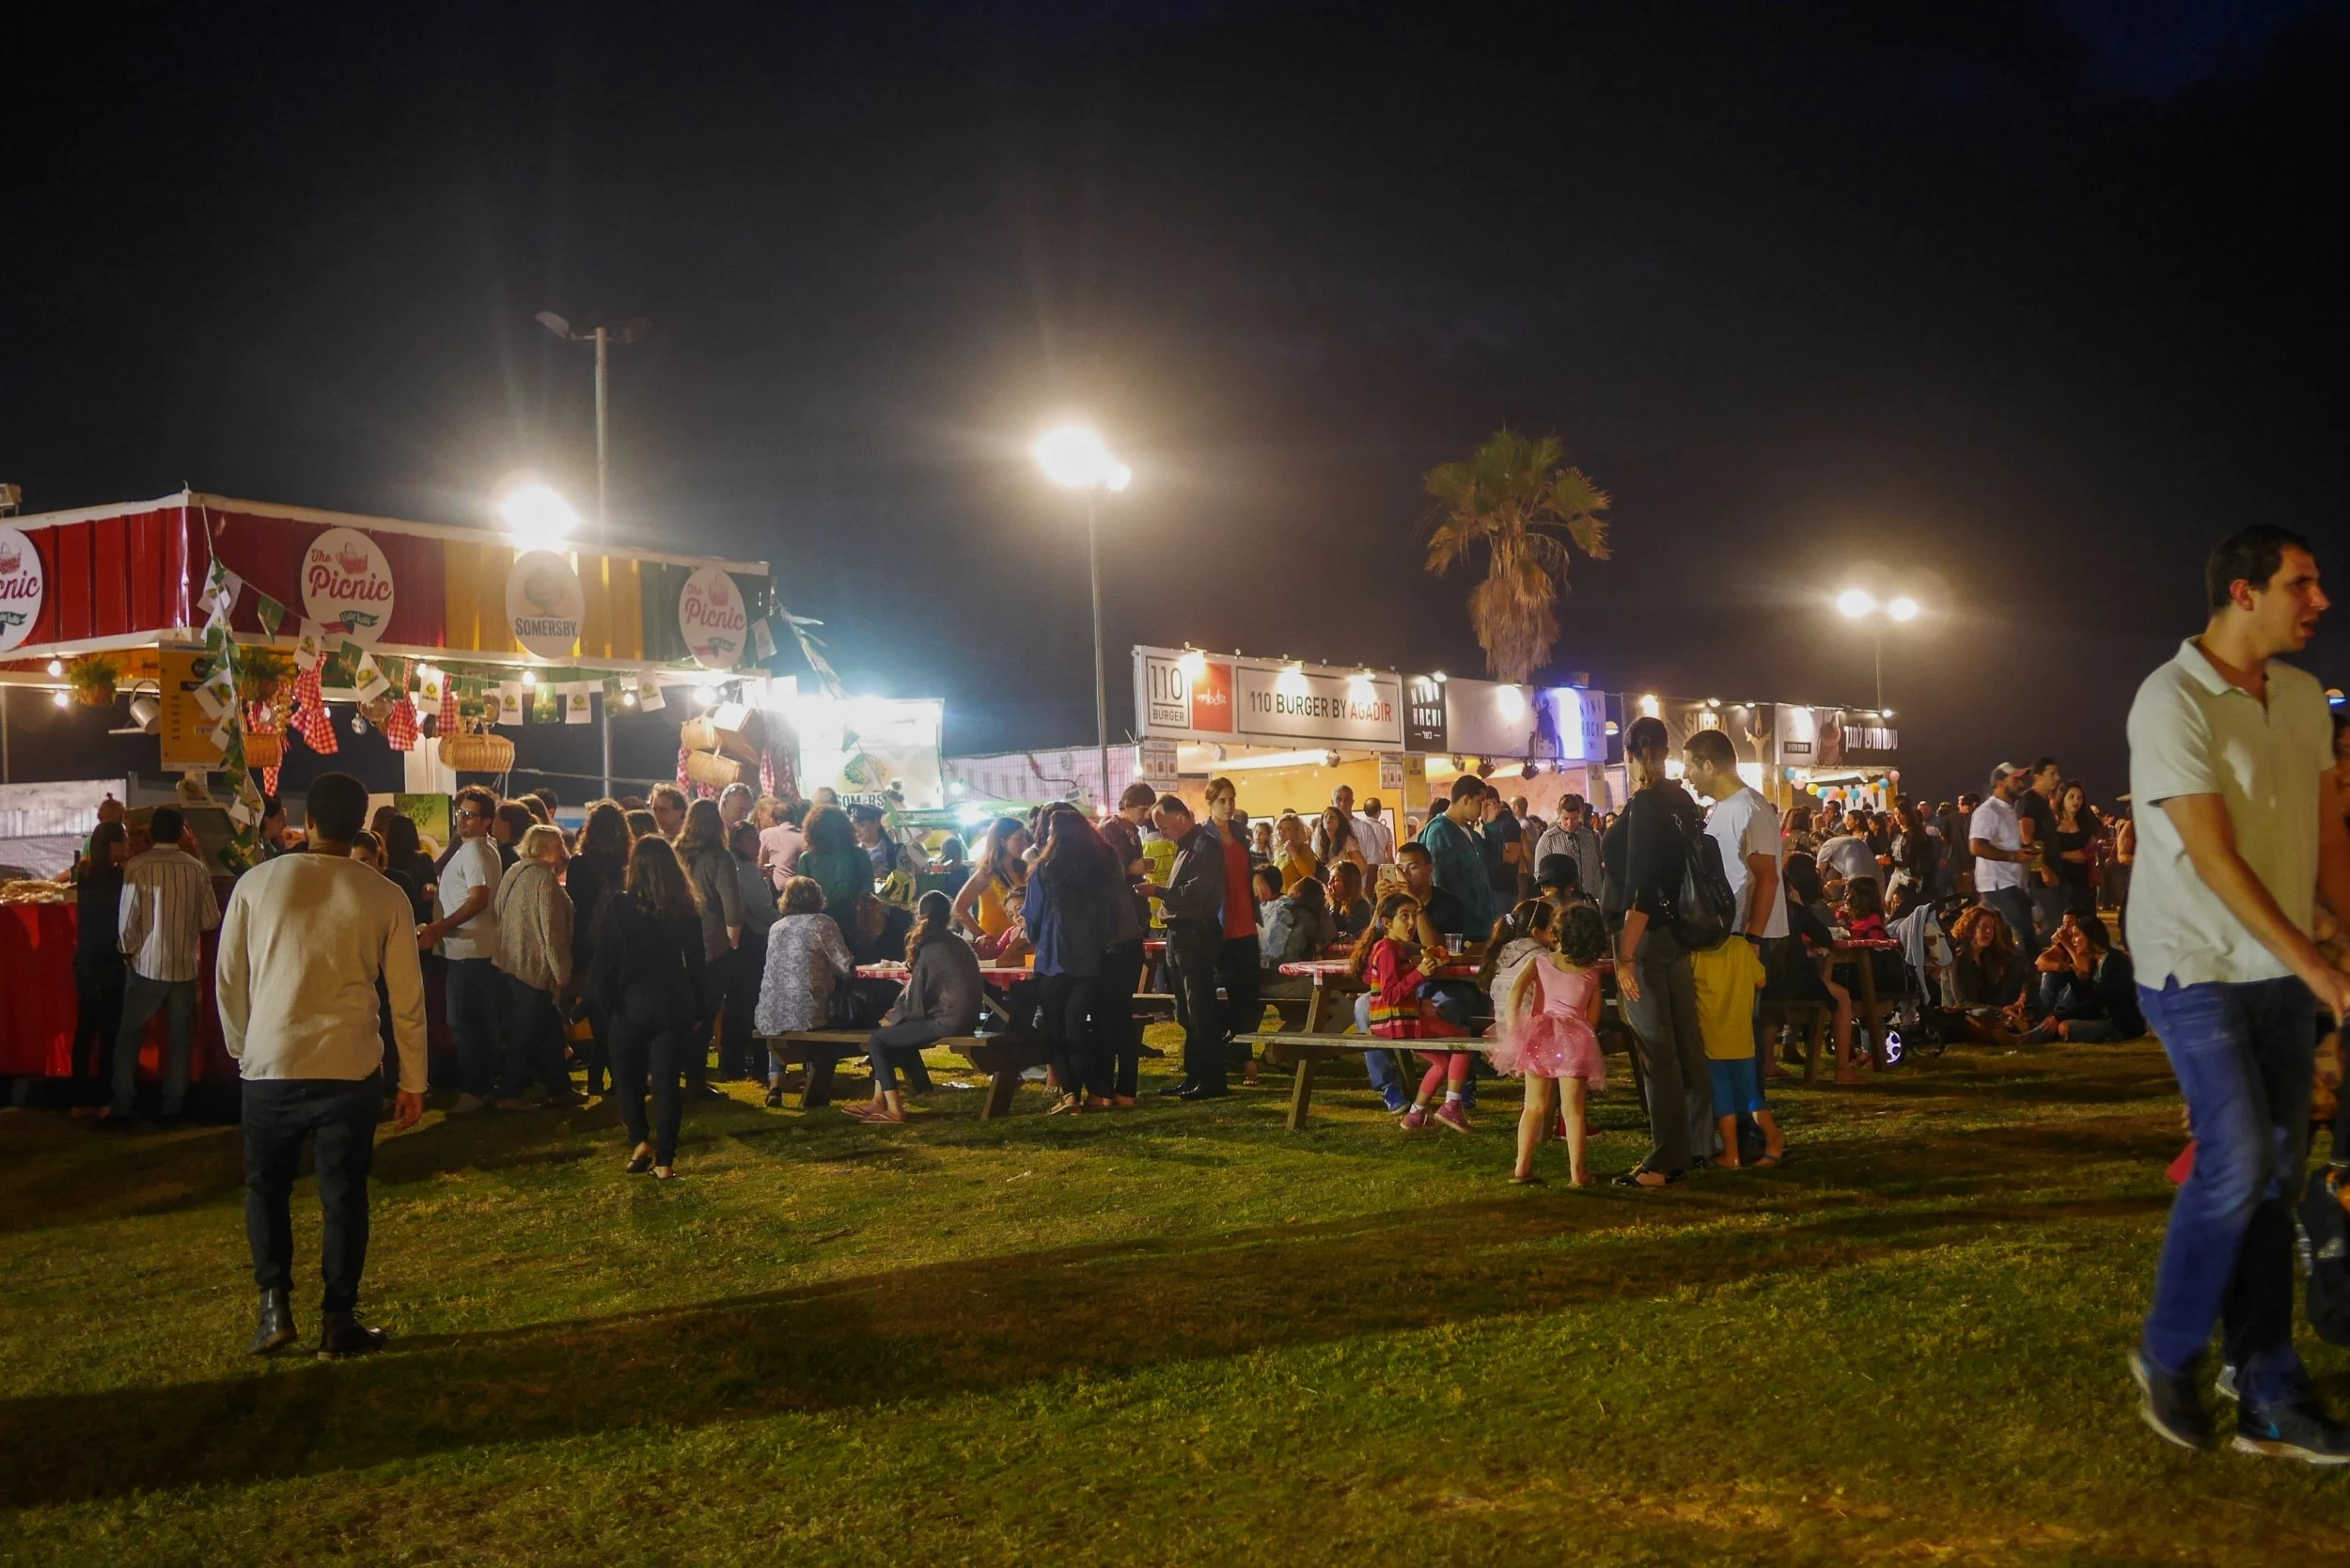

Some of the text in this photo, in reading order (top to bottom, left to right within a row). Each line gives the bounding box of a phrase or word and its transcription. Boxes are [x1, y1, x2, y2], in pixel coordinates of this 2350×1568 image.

[311, 549, 332, 563] The
[308, 564, 392, 601] Picnic
[515, 617, 577, 636] SOMERSBY
[684, 597, 745, 631] Picnic
[1152, 666, 1183, 700] 110
[1152, 708, 1184, 722] BURGER
[1250, 691, 1272, 713] 110
[1277, 693, 1328, 718] BURGER
[1332, 698, 1347, 719] BY
[1350, 700, 1391, 722] AGADIR
[1413, 708, 1441, 728] HACHI
